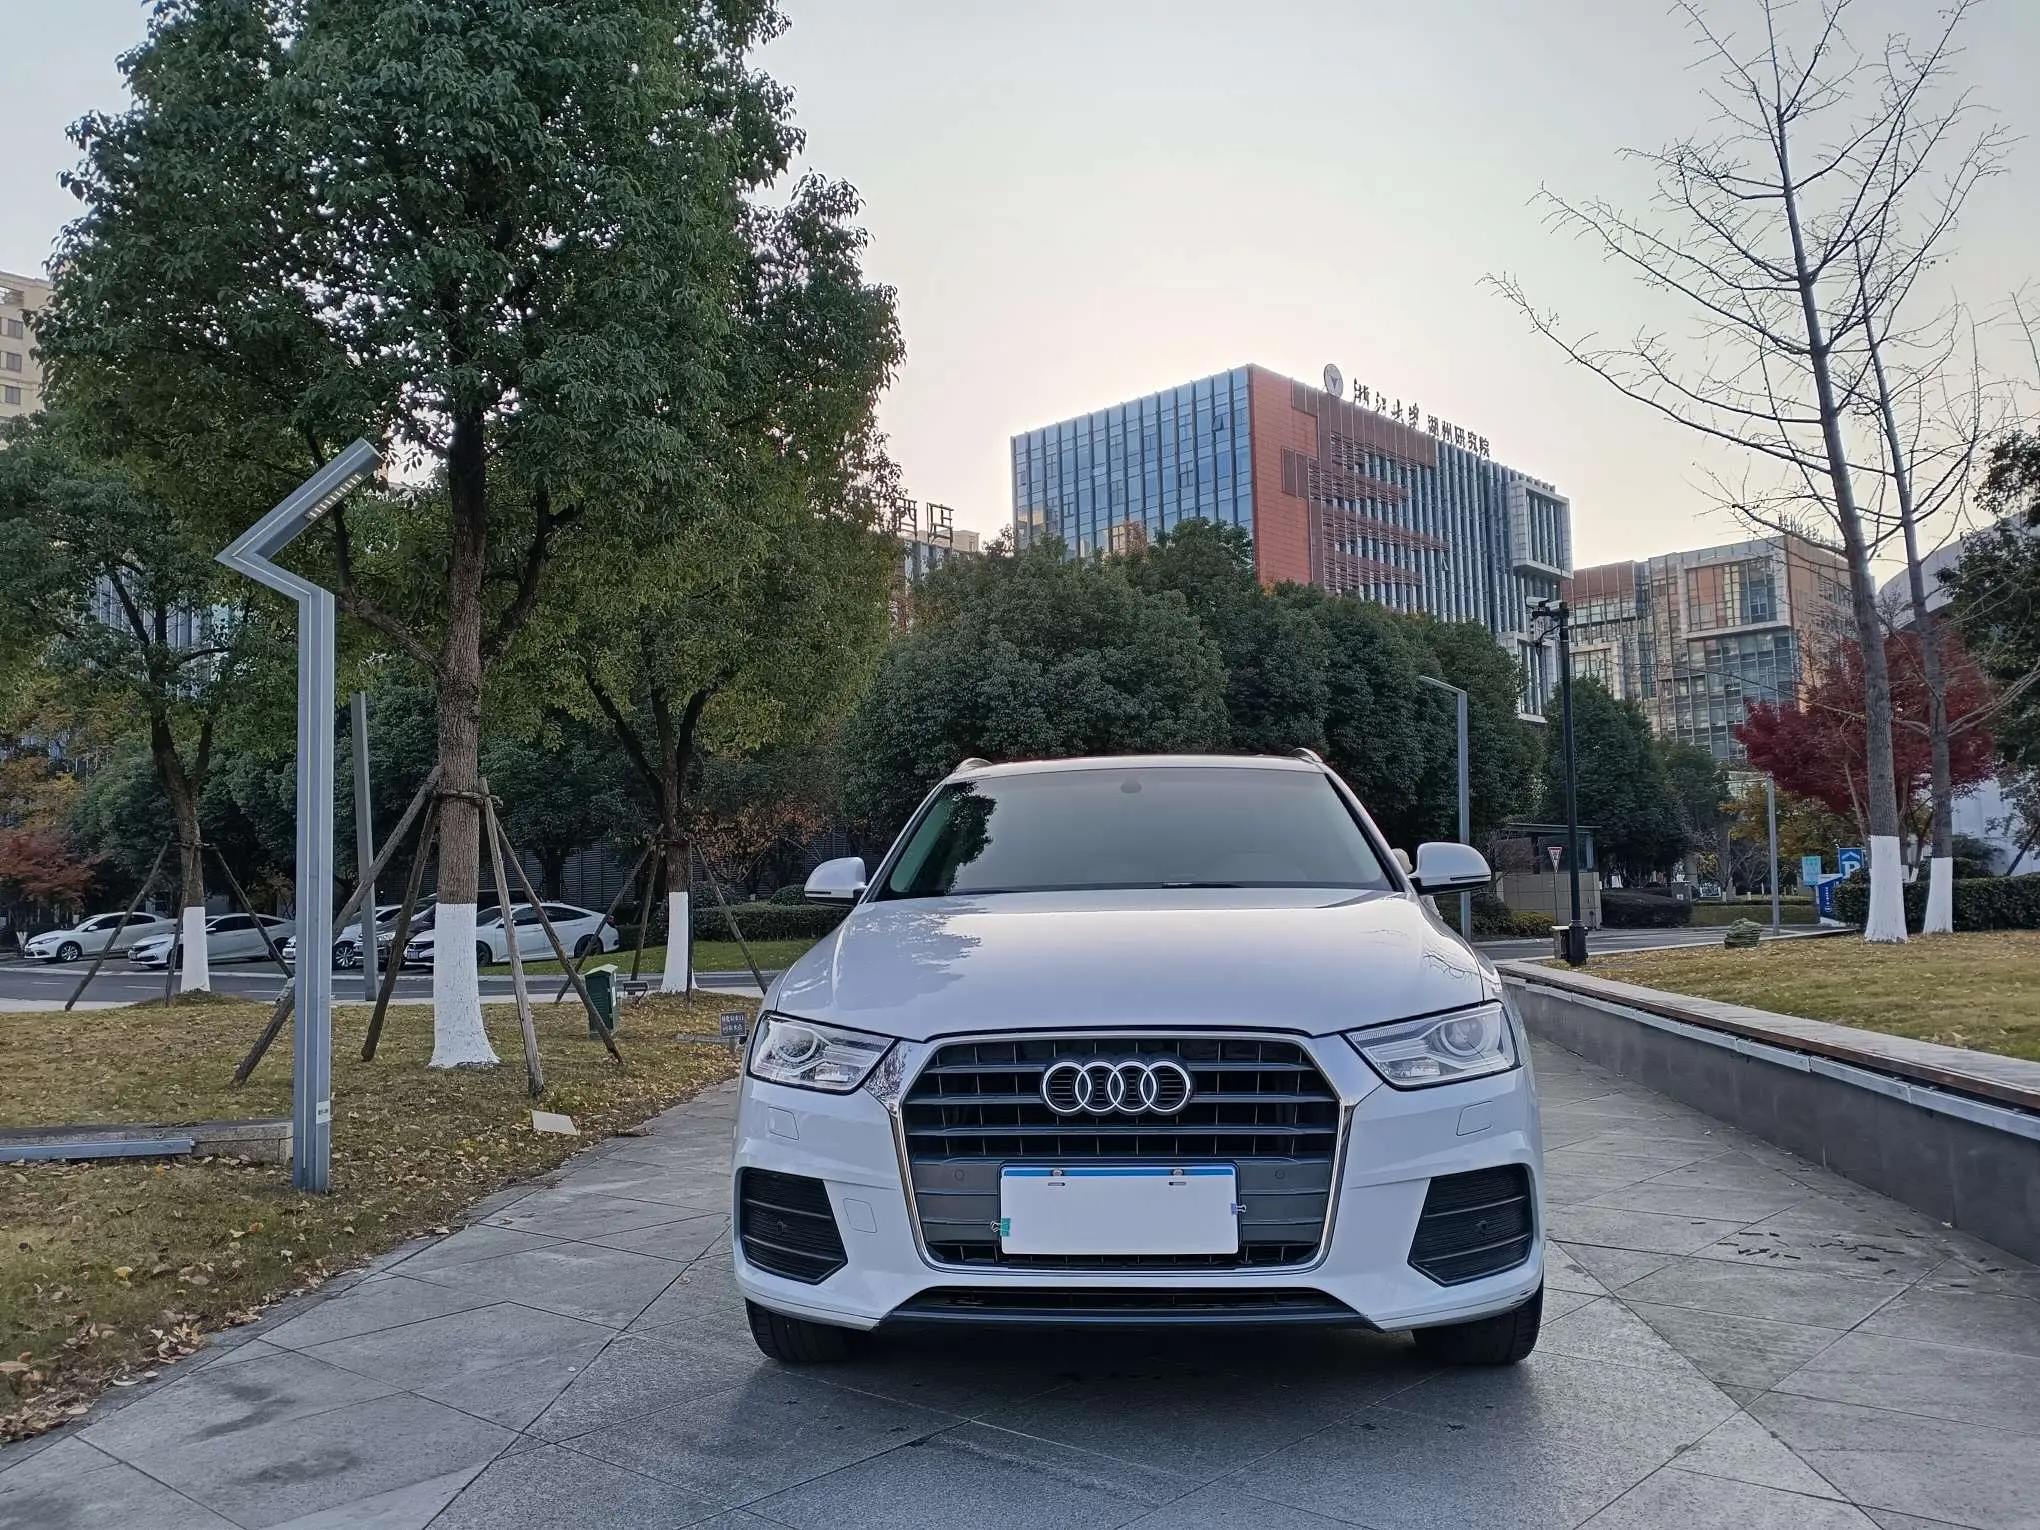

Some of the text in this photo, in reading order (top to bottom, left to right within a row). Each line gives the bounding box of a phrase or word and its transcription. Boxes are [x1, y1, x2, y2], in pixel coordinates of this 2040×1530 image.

[1427, 413, 1490, 457] 湖州研究院
[1841, 861, 1861, 880] P
